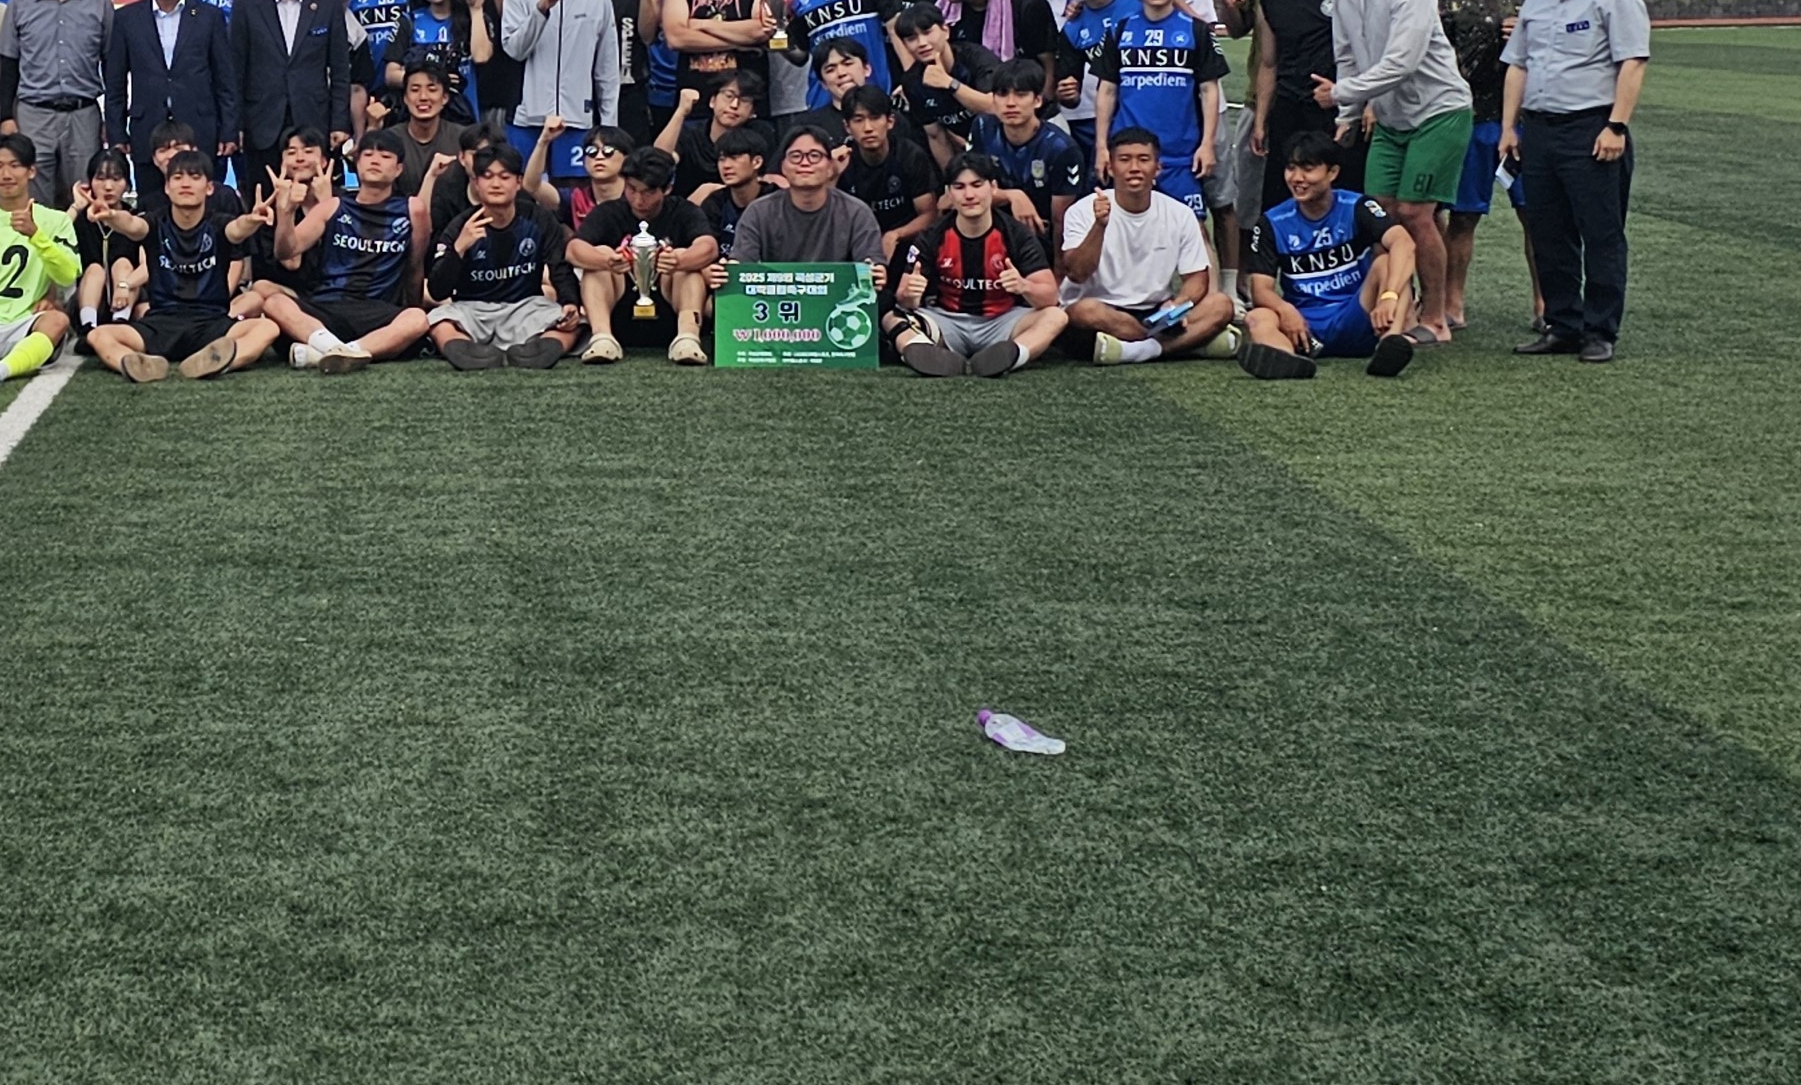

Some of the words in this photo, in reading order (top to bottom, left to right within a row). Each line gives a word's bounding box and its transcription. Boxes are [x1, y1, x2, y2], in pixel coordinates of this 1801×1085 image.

[359, 5, 401, 25] KNS
[1144, 29, 1164, 47] 29
[1120, 48, 1188, 66] KNSU
[333, 233, 405, 254] SEOULTECH
[1312, 227, 1332, 248] 25
[1291, 243, 1354, 273] KNSU
[470, 262, 536, 282] SEOULTECH
[753, 300, 769, 323] 3
[779, 300, 801, 323] 위
